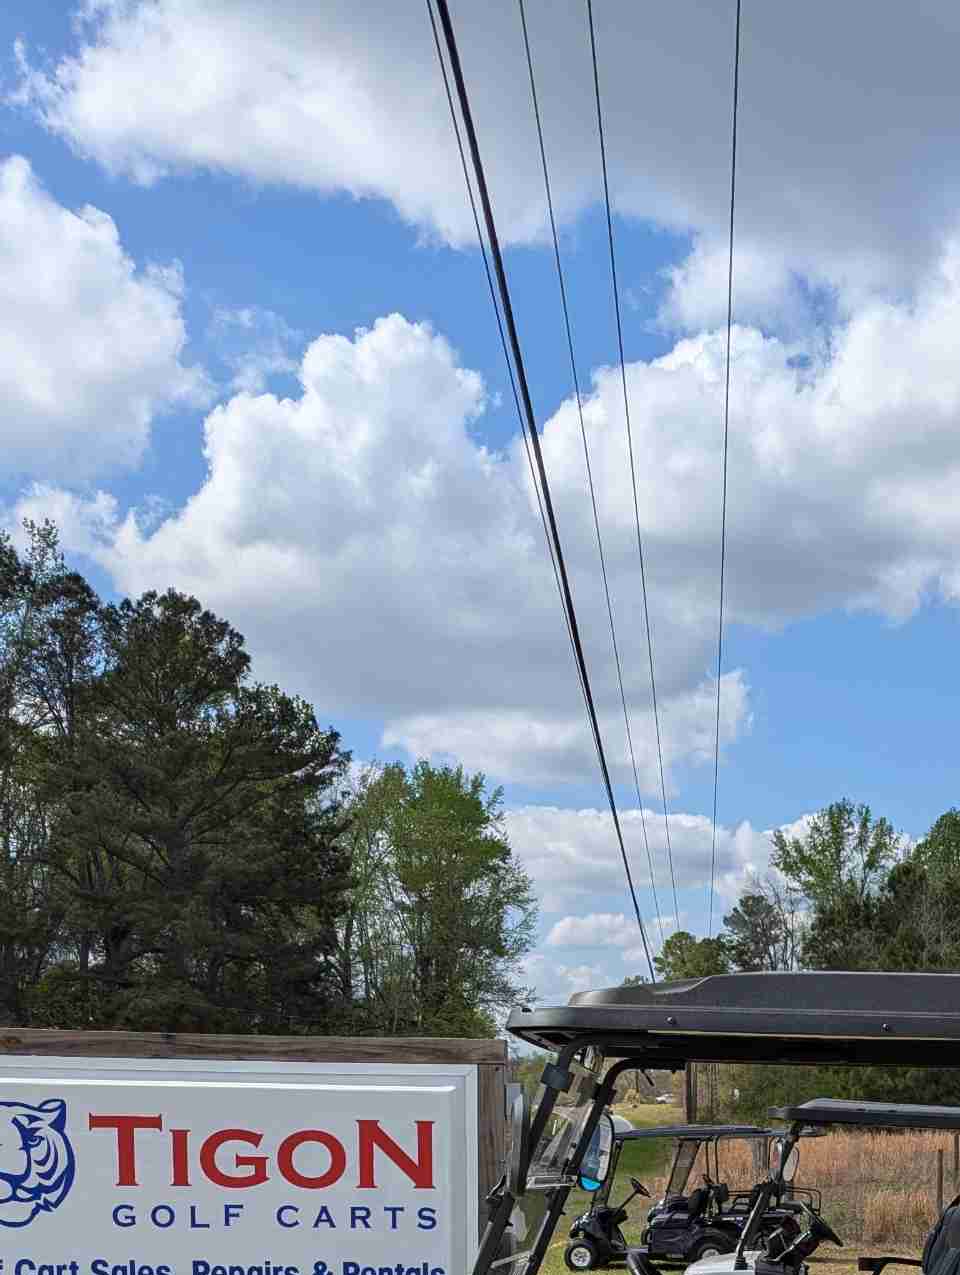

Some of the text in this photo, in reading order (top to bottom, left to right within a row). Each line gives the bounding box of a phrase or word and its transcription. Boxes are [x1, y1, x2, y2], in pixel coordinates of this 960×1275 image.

[89, 1113, 435, 1189] TIGON
[113, 1204, 437, 1230] GOLF CARTS
